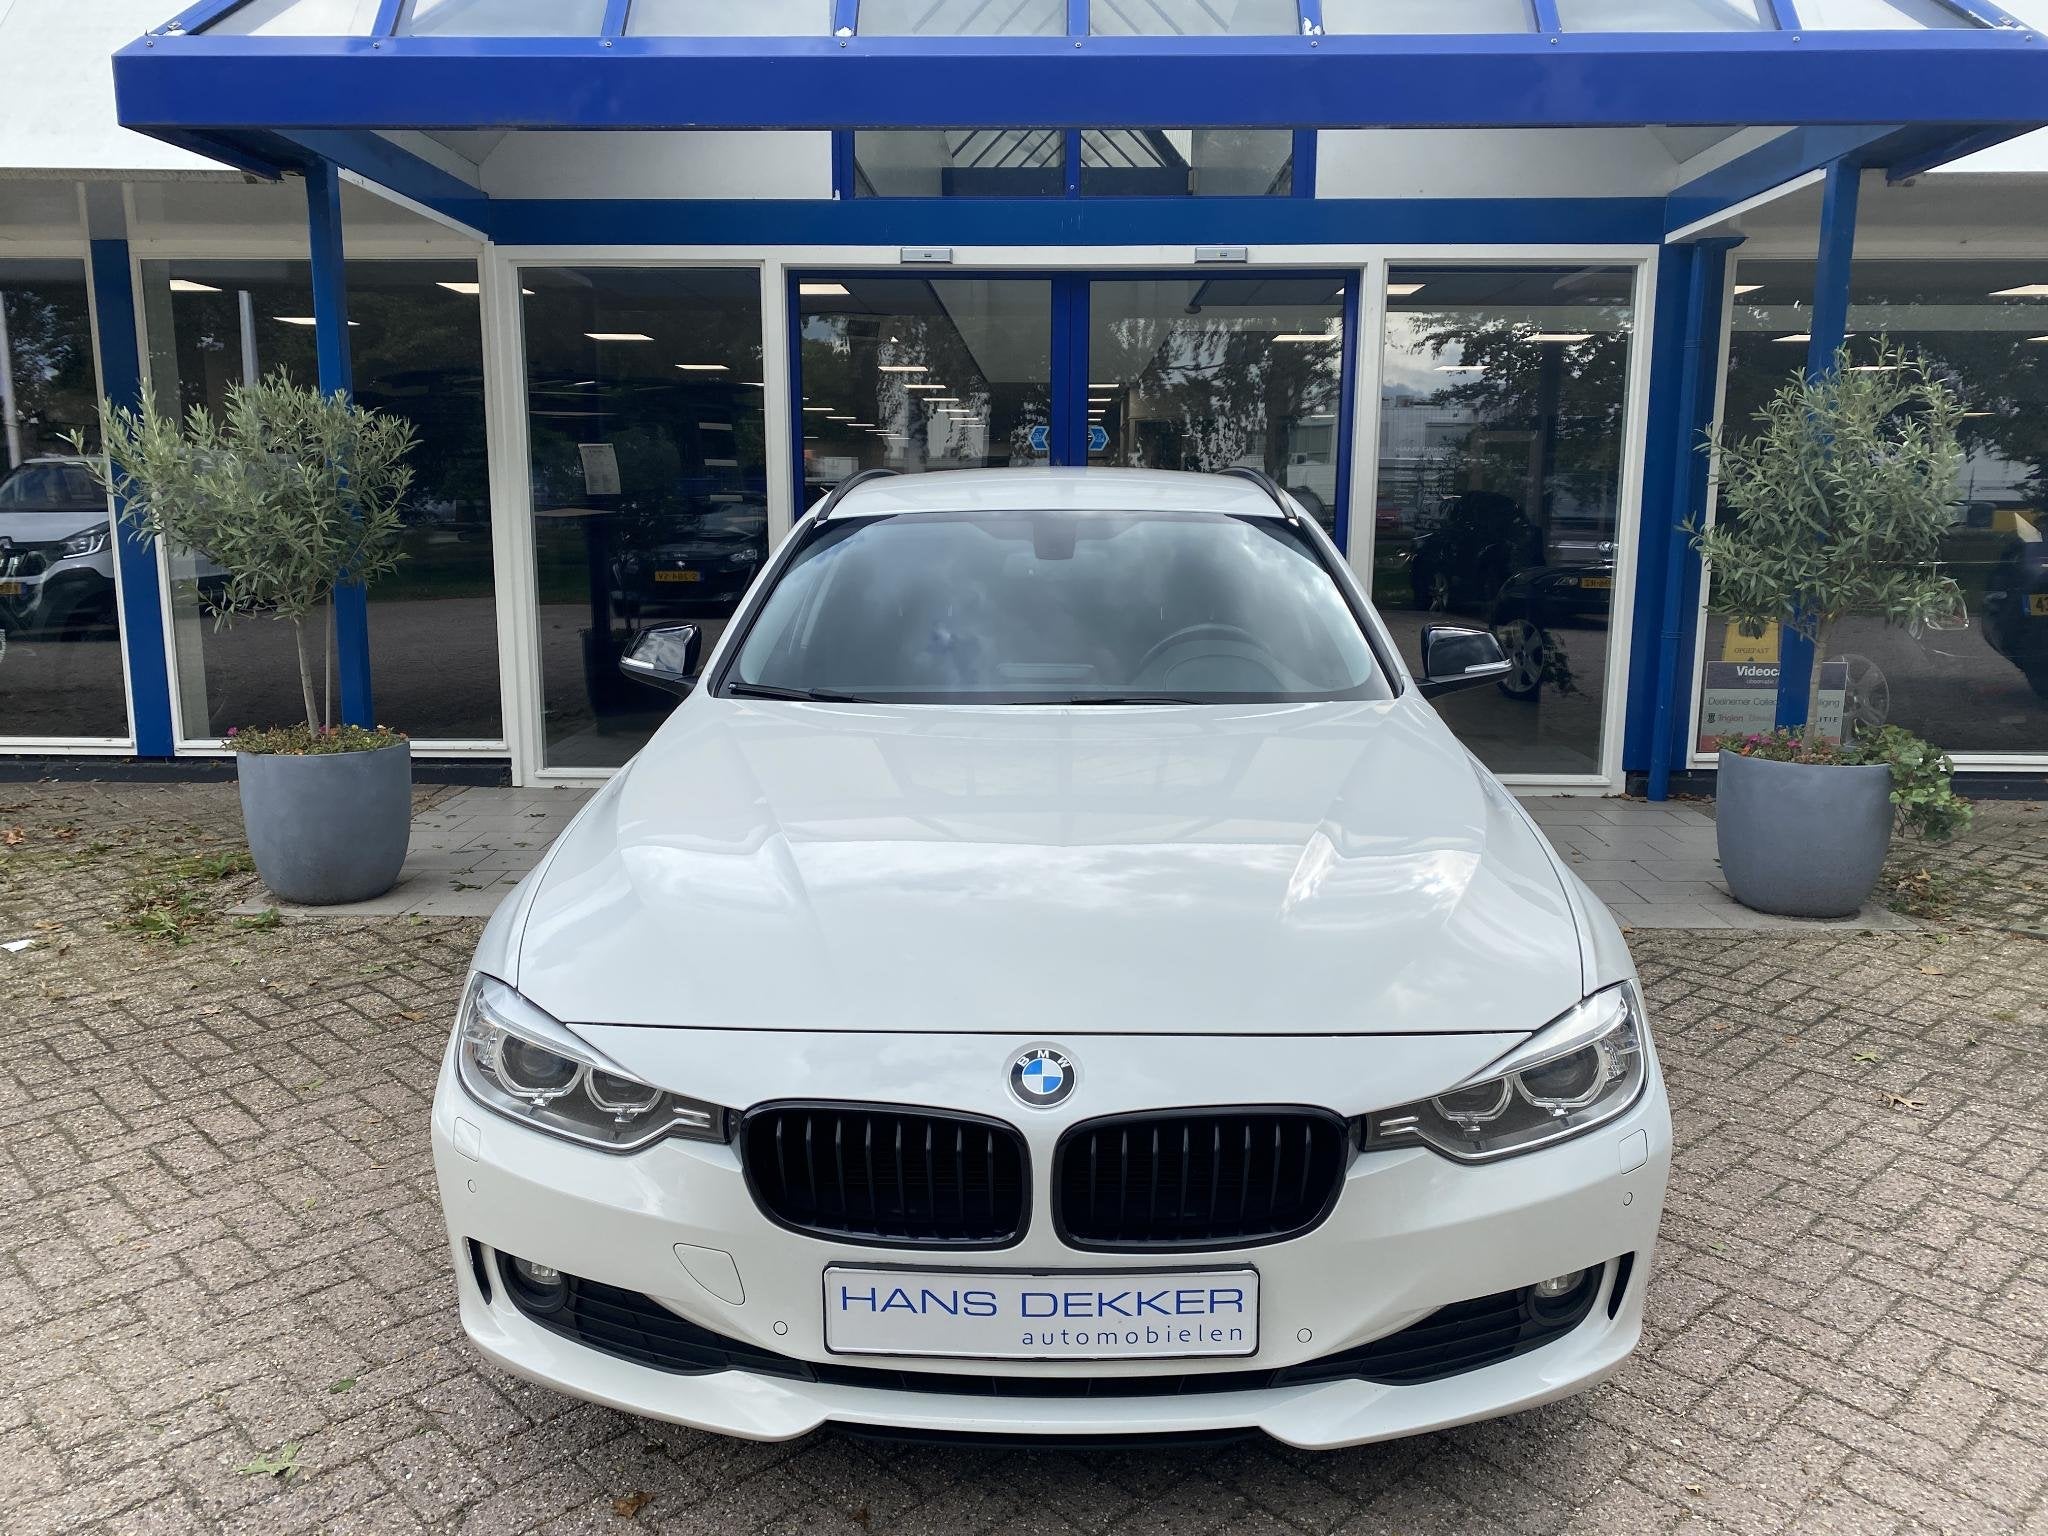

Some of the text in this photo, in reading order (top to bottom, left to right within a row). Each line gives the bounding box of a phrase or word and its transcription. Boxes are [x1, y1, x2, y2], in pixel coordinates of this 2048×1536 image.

[1736, 665, 1780, 677] Videoc
[1017, 1049, 1071, 1068] BMW
[841, 1285, 1244, 1318] HANS DEKKER
[1022, 1325, 1243, 1346] automobielen
